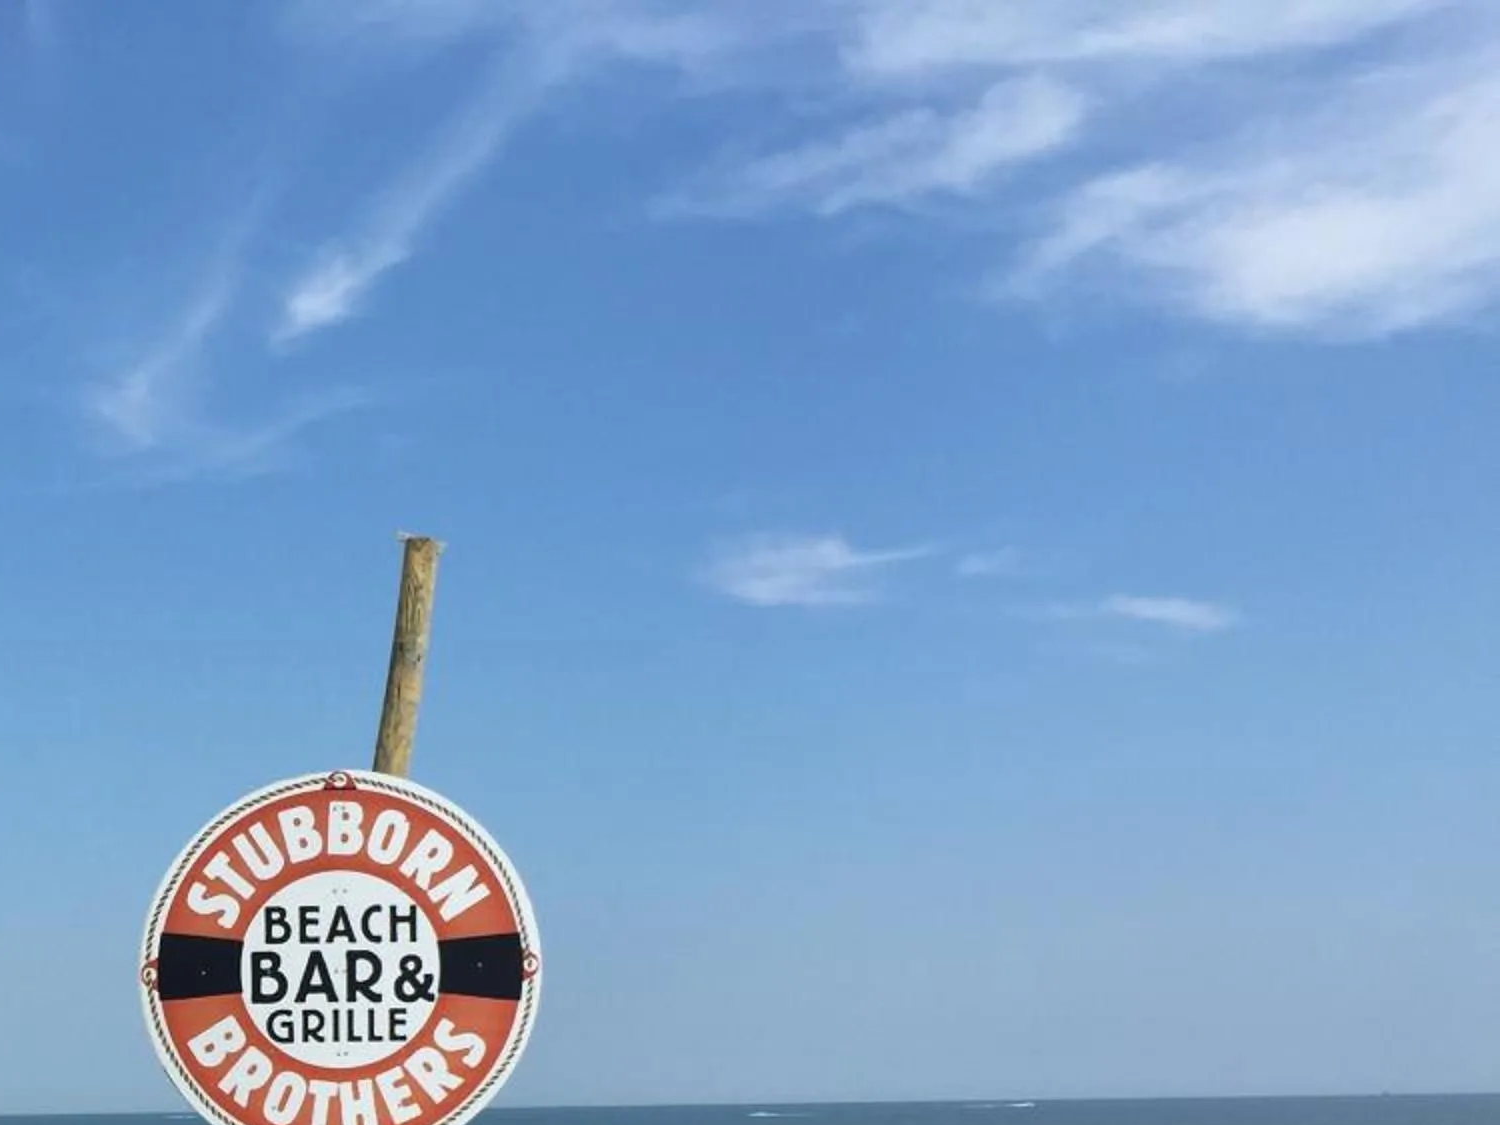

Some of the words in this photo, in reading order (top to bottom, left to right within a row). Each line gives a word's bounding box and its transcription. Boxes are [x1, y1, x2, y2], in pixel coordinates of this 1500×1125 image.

[187, 800, 491, 929] STUBBORN
[263, 904, 418, 945] BEACH
[250, 950, 383, 1005] BAR
[393, 953, 435, 1004] &
[266, 1008, 408, 1044] GRILLE
